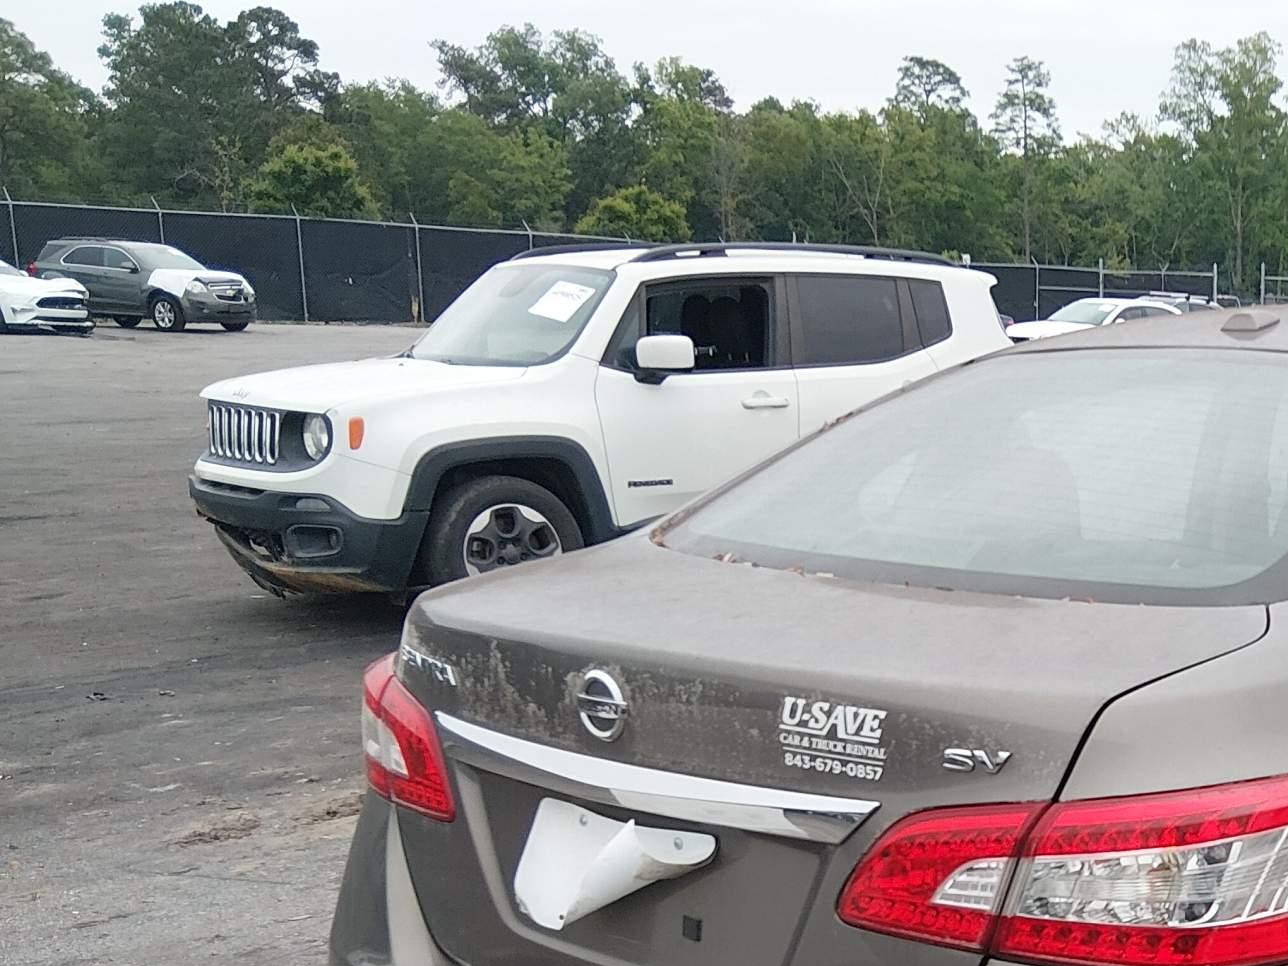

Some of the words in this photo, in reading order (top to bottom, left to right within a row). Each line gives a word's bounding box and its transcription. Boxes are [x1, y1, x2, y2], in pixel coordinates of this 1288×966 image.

[780, 696, 888, 740] U-SAVE
[779, 732, 801, 747] CAR
[801, 736, 810, 748] &
[811, 737, 846, 754] TRUCK
[845, 743, 888, 760] RENTAL
[784, 752, 884, 782] 843-679-0857
[942, 748, 1013, 775] SV
